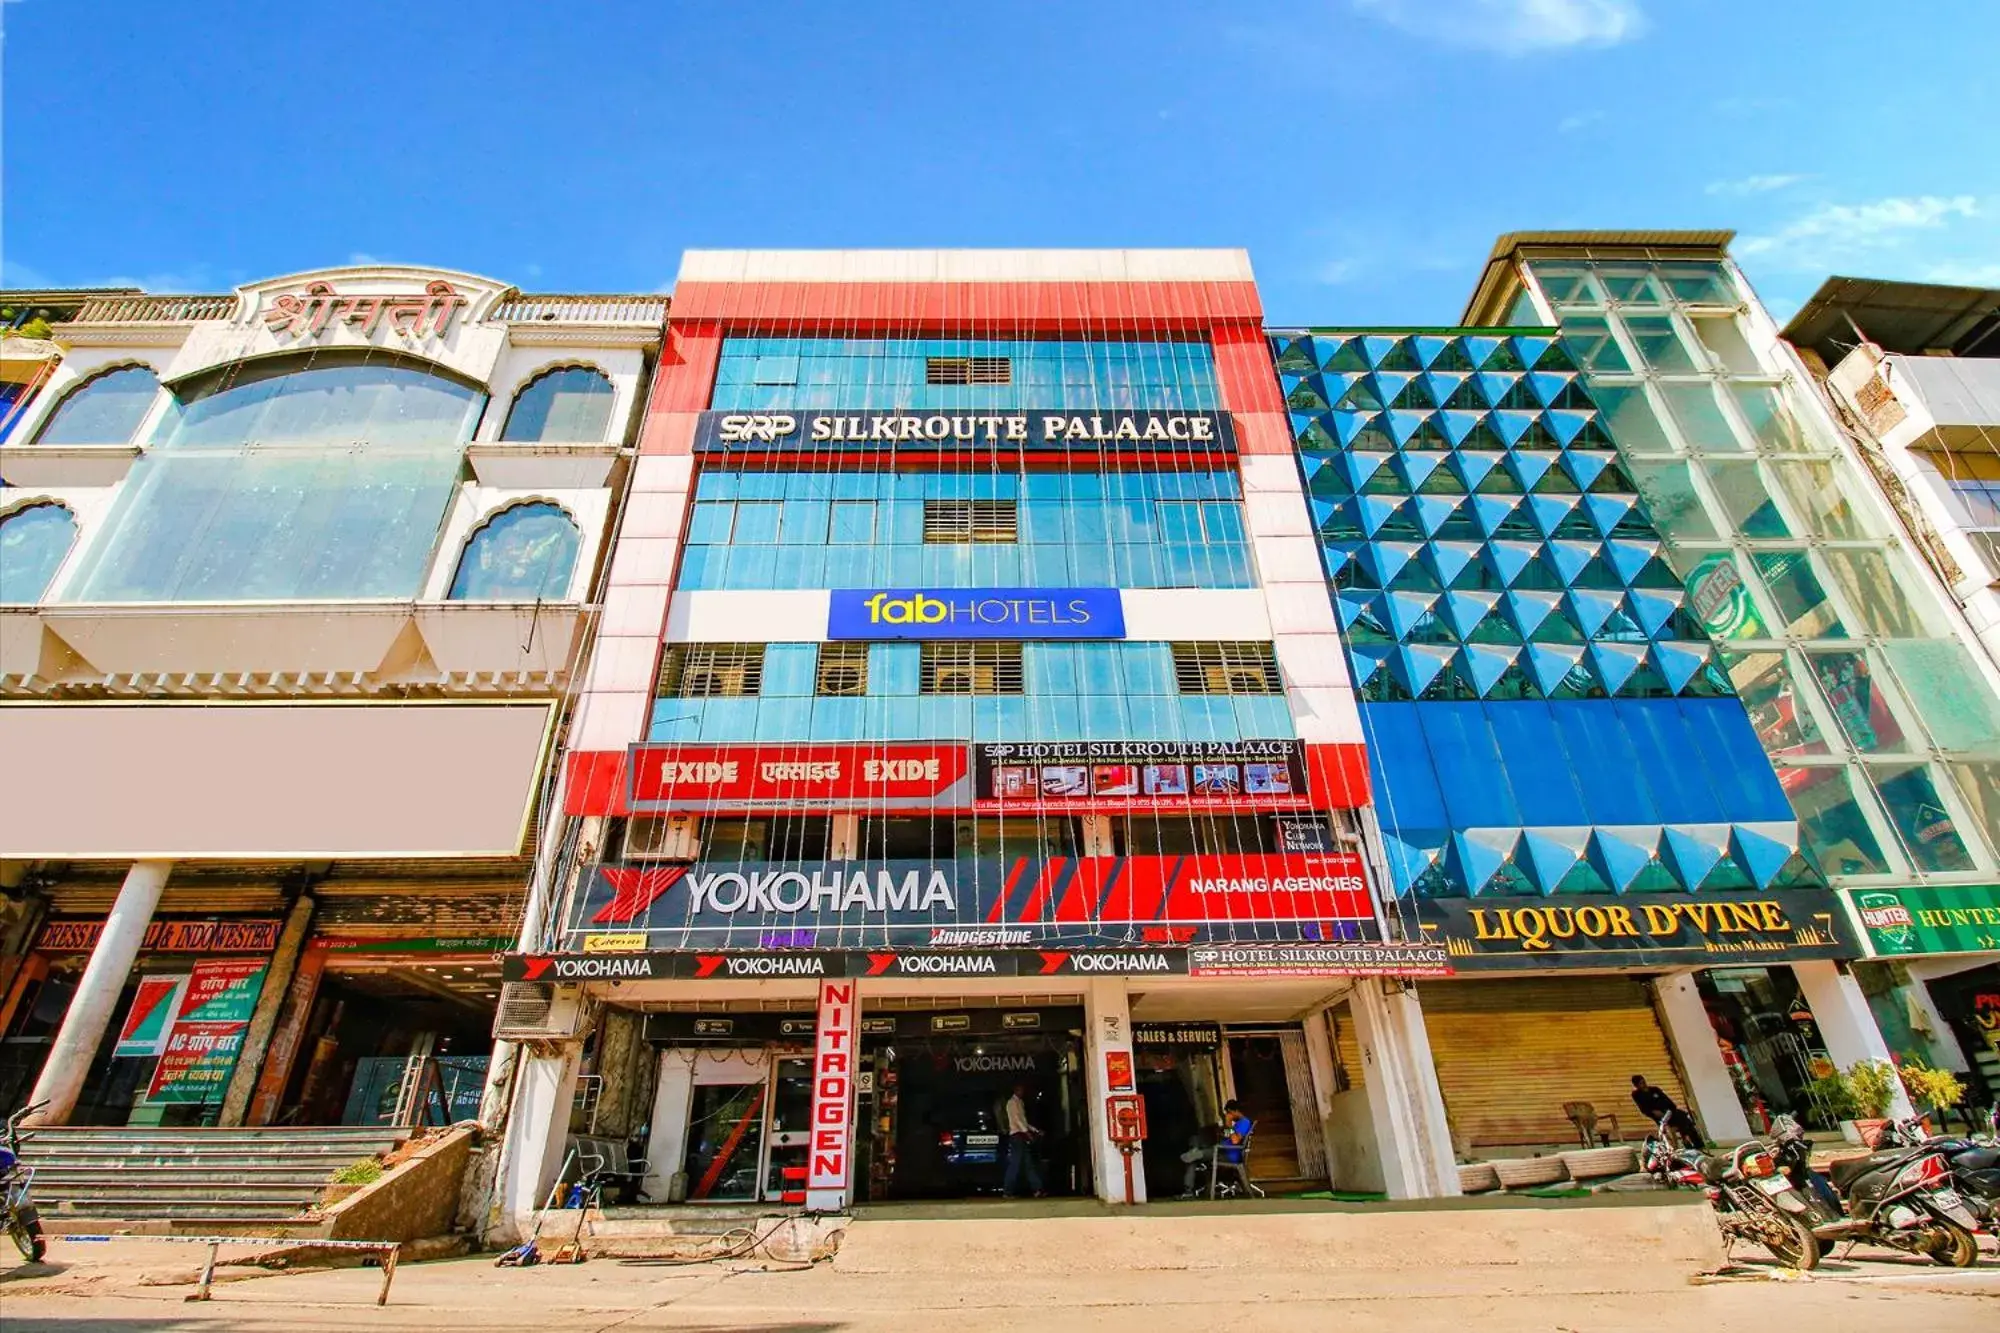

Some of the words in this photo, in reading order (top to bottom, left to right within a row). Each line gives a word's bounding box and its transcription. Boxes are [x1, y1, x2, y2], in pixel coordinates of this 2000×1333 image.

[260, 280, 468, 338] श्रीमती
[811, 415, 1028, 441] SILKROUTE
[1044, 414, 1213, 441] PALAACE
[864, 594, 1090, 625] fabHOTELS
[1018, 744, 1088, 757] HOTEL
[1089, 743, 1202, 757] SILKROUTE
[1207, 742, 1294, 754] PALAACE
[661, 762, 738, 783] EXIDE
[761, 761, 840, 786] एक्साइड
[863, 759, 940, 781] EXIDE
[685, 870, 956, 913] YOKOHAMA
[1191, 877, 1267, 893] NARANG
[1272, 876, 1363, 892] AGENCIES
[1862, 908, 1911, 926] HUNTER
[1469, 905, 1640, 950] LIQUOR
[897, 956, 996, 973] YOKOHAMA
[1070, 954, 1169, 971] YOKOHAMA
[1220, 950, 1278, 962] HOTEL
[1280, 949, 1373, 961] SILKROUTE
[1375, 949, 1447, 961] PALAACE
[554, 959, 651, 976] YOKOHAMA
[726, 957, 824, 974] YOKOHAMA
[168, 1033, 188, 1051] AC
[188, 1031, 216, 1051] शॉप
[217, 1035, 241, 1051] बार
[1136, 1031, 1166, 1043] SALES
[1168, 1032, 1175, 1042] &
[1177, 1030, 1217, 1043] SERVICE
[954, 1056, 1035, 1072] YOKOHAMA
[814, 985, 850, 1176] NITROGEN
